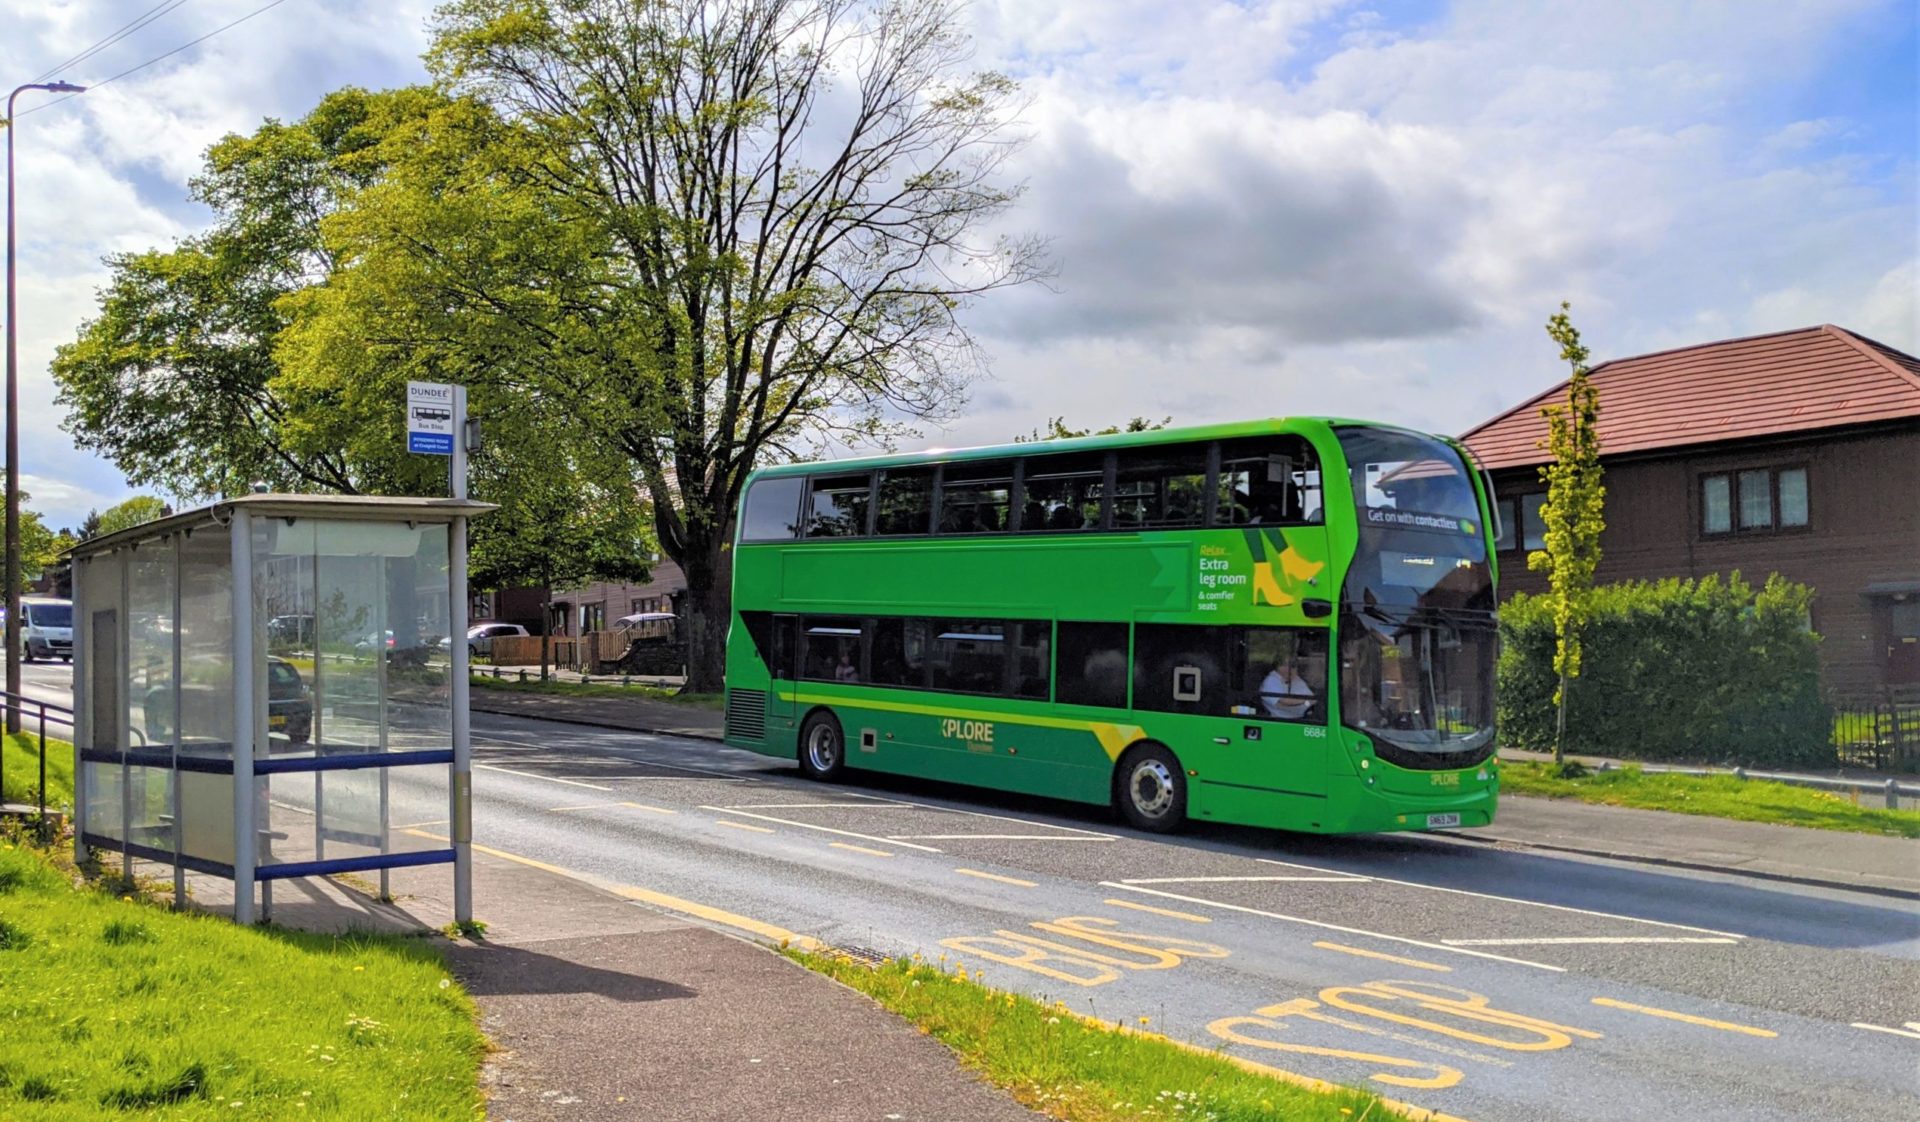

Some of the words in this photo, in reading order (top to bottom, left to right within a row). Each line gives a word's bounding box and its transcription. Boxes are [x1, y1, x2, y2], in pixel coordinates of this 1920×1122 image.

[411, 387, 448, 398] DUNDEE
[1368, 510, 1383, 522] Get
[1385, 513, 1396, 522] on
[1398, 513, 1415, 525] with
[1415, 516, 1458, 530] contactless
[1200, 558, 1229, 571] Extra
[1200, 572, 1217, 588] leg
[1218, 575, 1247, 585] room
[1198, 591, 1205, 600] &
[1206, 591, 1235, 600] comfier
[1198, 602, 1217, 611] seats
[1304, 727, 1326, 738] 6684
[939, 915, 1232, 987] BUS
[1206, 979, 1605, 1090] STOP
